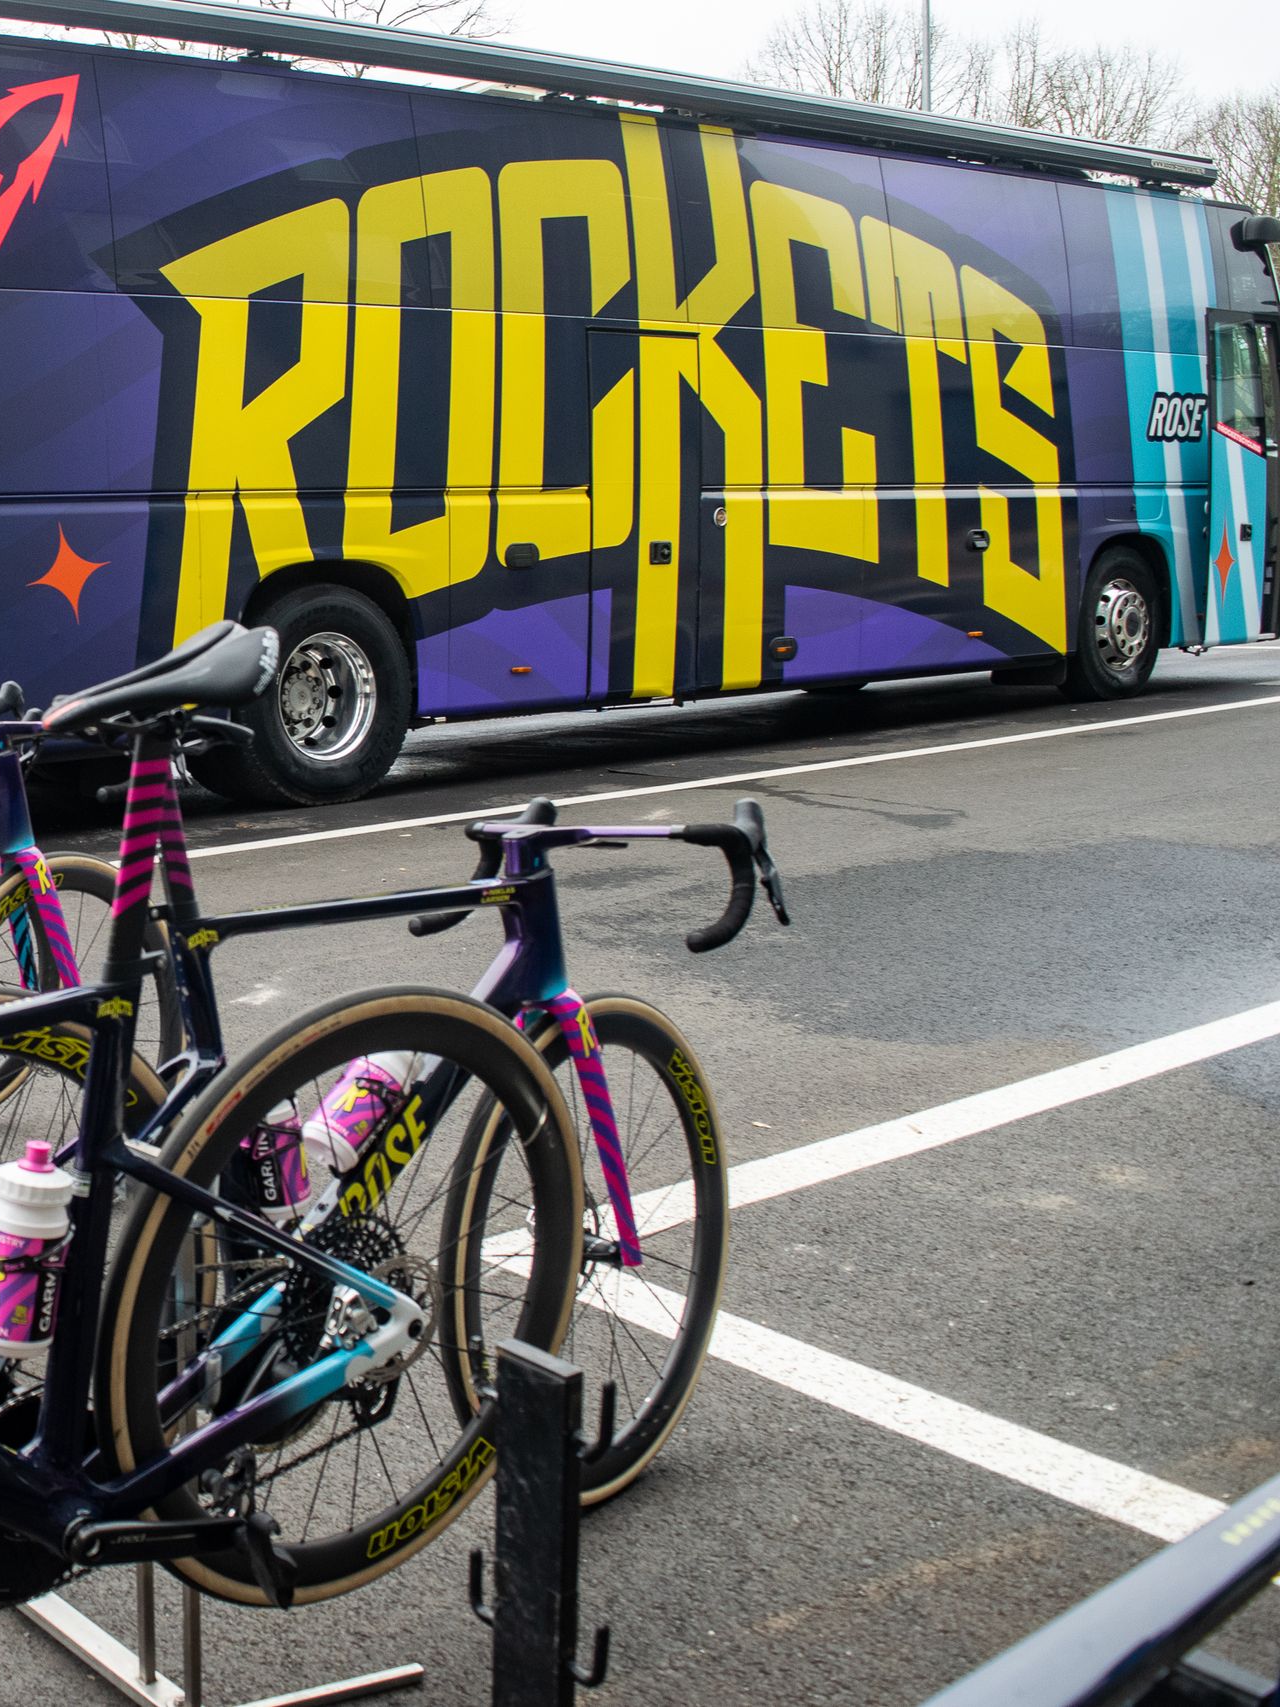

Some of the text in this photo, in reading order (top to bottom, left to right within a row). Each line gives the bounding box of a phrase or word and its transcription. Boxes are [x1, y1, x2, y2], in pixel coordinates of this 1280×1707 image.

[161, 112, 1067, 698] ROCKETS
[1148, 397, 1207, 437] ROSE
[576, 1006, 595, 1058] R
